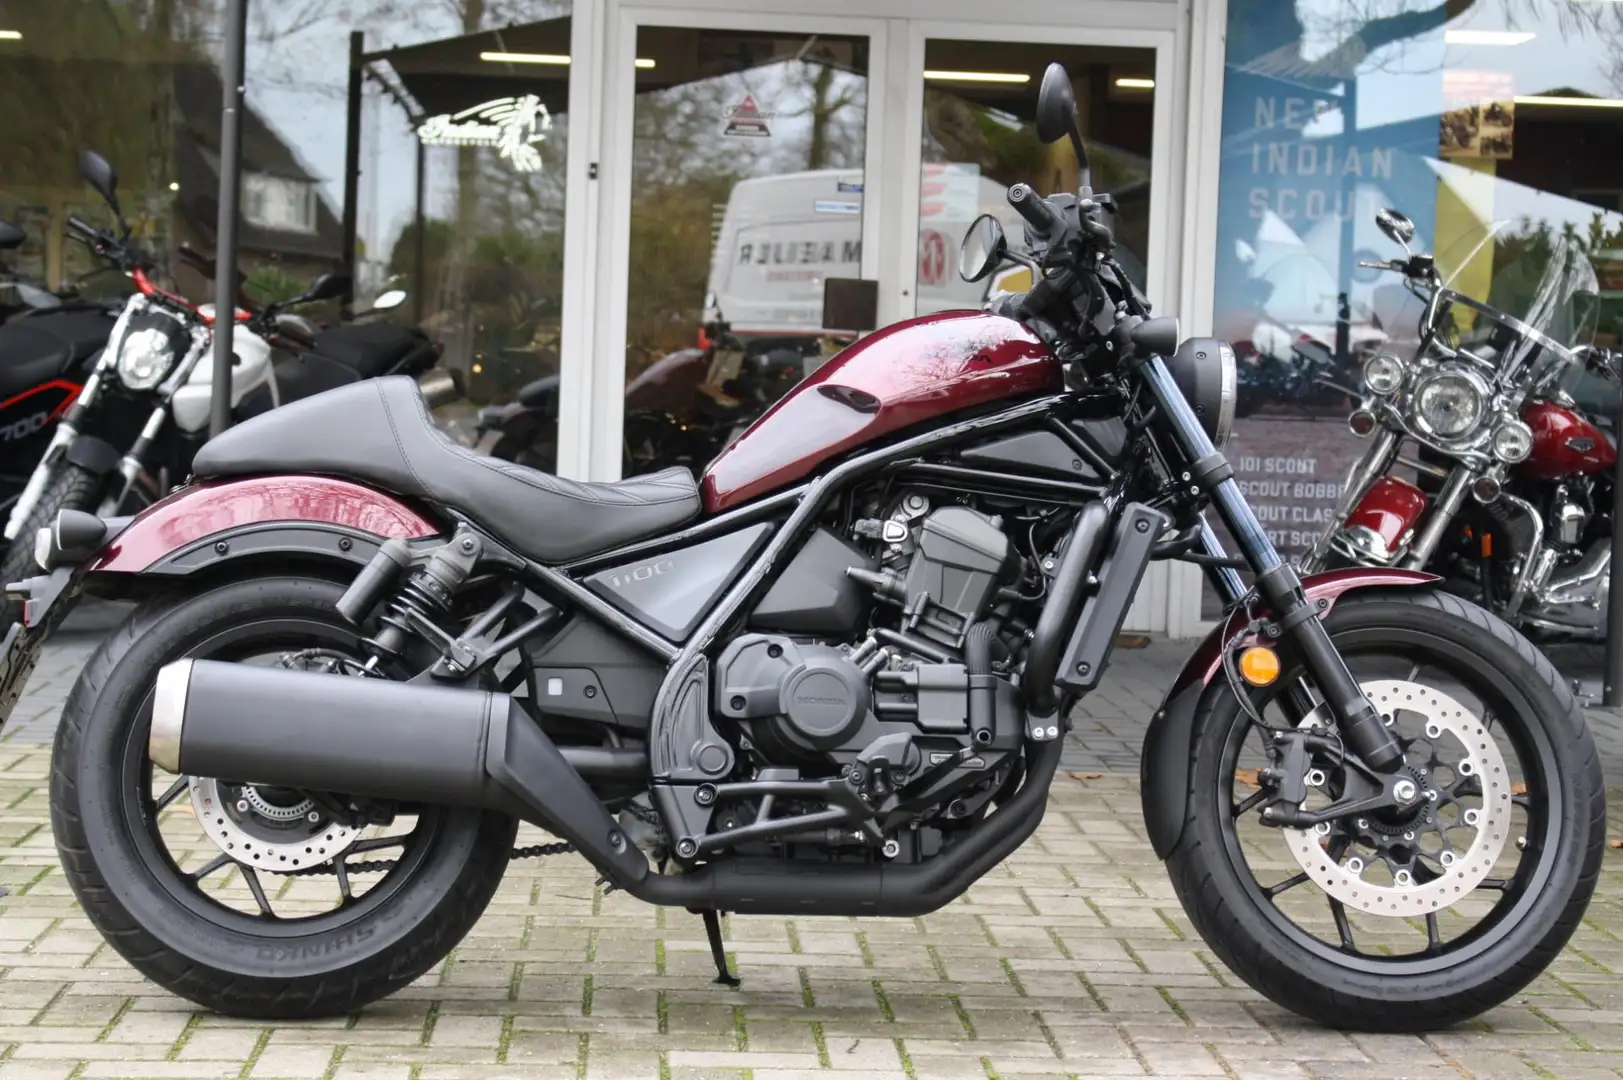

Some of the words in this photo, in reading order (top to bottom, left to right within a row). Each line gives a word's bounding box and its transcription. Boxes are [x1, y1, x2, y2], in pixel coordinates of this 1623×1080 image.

[1251, 141, 1396, 180] INDIAN
[1240, 456, 1260, 473] 101
[1264, 457, 1317, 474] SCOUT
[1240, 480, 1291, 497] SCOUT
[254, 922, 377, 962] SHINKO
